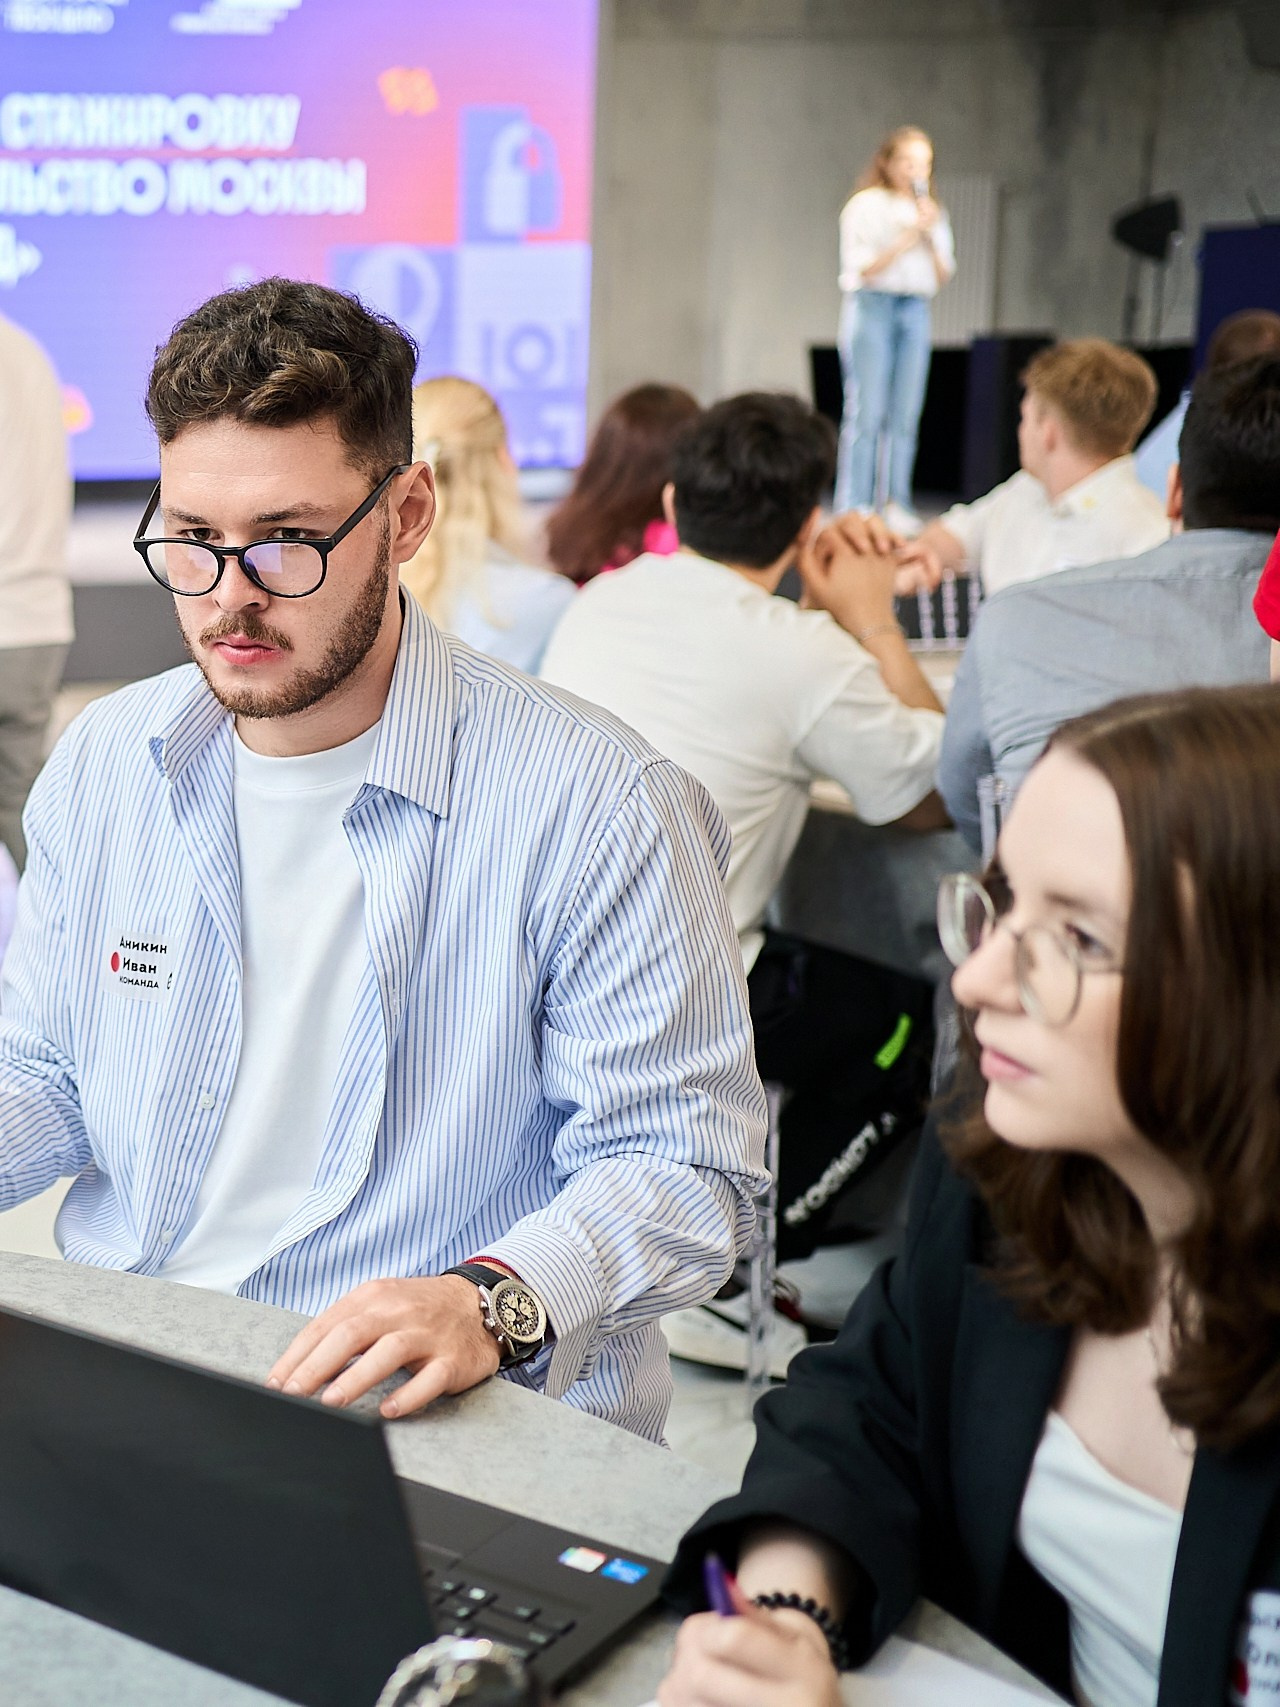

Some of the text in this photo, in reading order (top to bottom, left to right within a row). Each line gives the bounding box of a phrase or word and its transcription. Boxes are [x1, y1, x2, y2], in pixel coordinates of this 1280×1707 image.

[0, 92, 301, 150] СТАЖИРОВКУ
[168, 159, 367, 214] МОСКВЫ
[119, 936, 167, 954] Аникин
[122, 957, 157, 974] Иван
[119, 976, 159, 989] КОМАНДА
